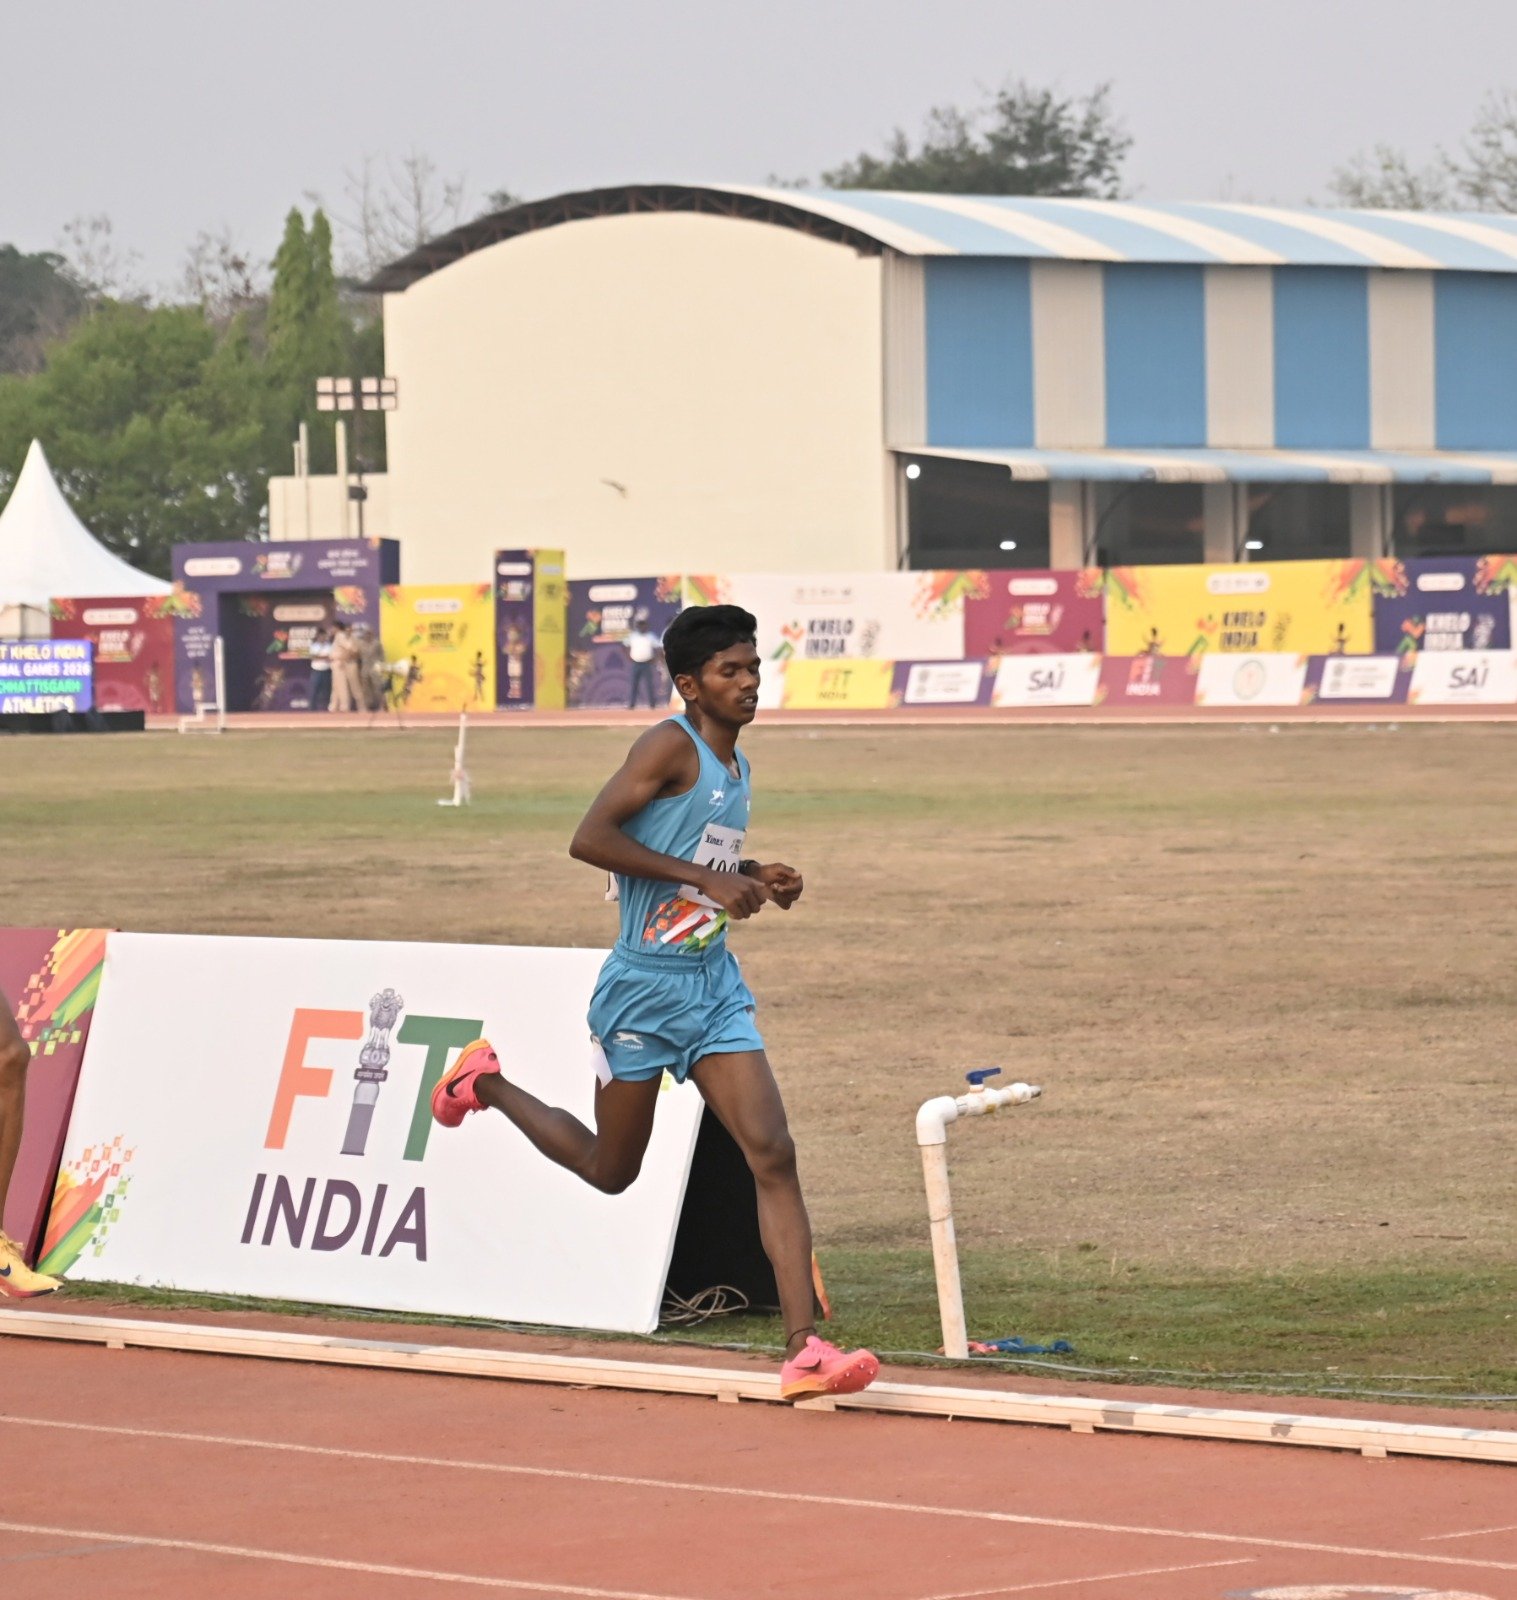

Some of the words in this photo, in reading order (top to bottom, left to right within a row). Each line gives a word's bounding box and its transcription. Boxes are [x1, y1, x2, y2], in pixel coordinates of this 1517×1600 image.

[808, 619, 854, 636] KHELO
[11, 644, 51, 660] KHELO
[54, 645, 85, 660] INDIA
[805, 638, 846, 657] INDIA
[23, 662, 60, 677] GAMES
[263, 987, 484, 1162] FIT
[240, 1173, 427, 1262] INDIA
